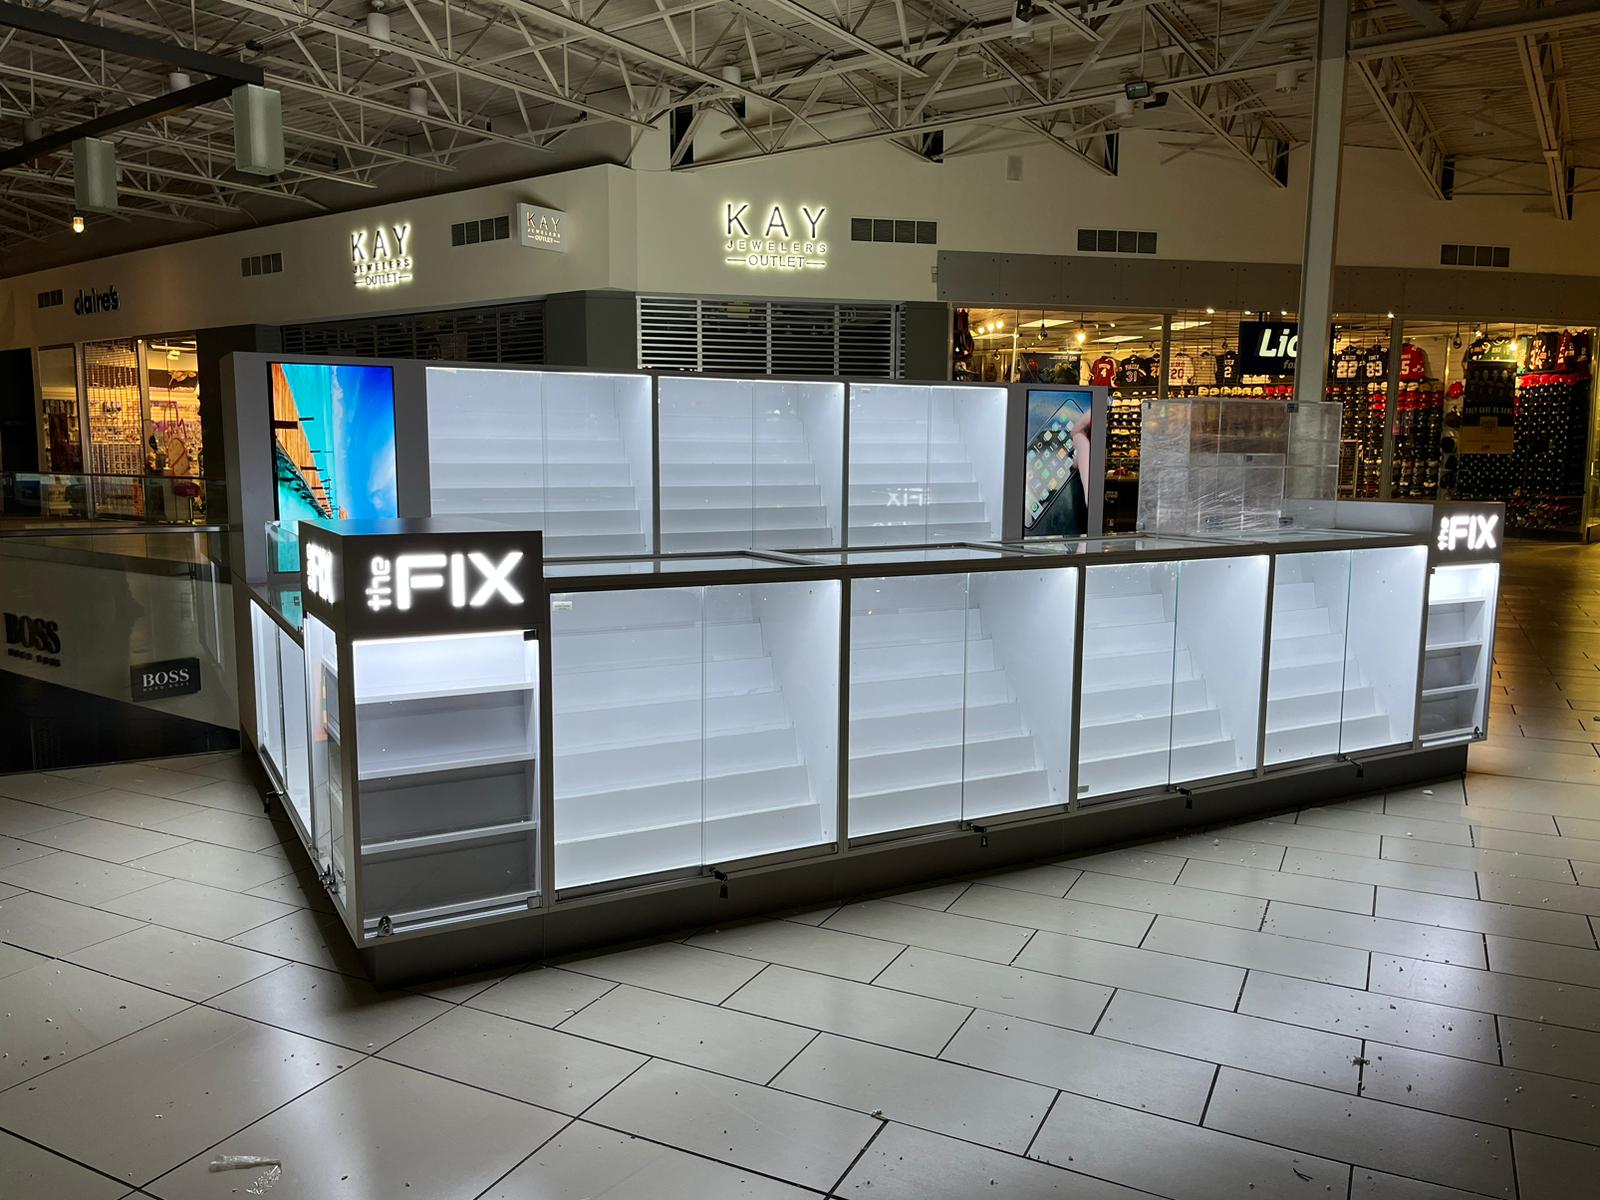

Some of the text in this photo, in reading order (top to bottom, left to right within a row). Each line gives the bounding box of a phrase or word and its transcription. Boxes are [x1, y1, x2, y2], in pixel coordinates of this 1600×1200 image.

[527, 211, 561, 232] KAY
[727, 203, 826, 239] KAY
[351, 225, 408, 262] KAY
[534, 235, 553, 243] OUTLET
[727, 240, 826, 253] JEWELERS
[352, 259, 410, 274] JEWELERS
[748, 255, 805, 267] OUTLET
[365, 273, 398, 285] OUTLET
[74, 285, 119, 315] claire's
[1282, 359, 1296, 369] fo
[1448, 514, 1499, 550] FIX
[365, 556, 392, 611] the
[396, 551, 525, 610] FIX
[3, 613, 60, 653] BOSS
[142, 668, 190, 687] BOSS
